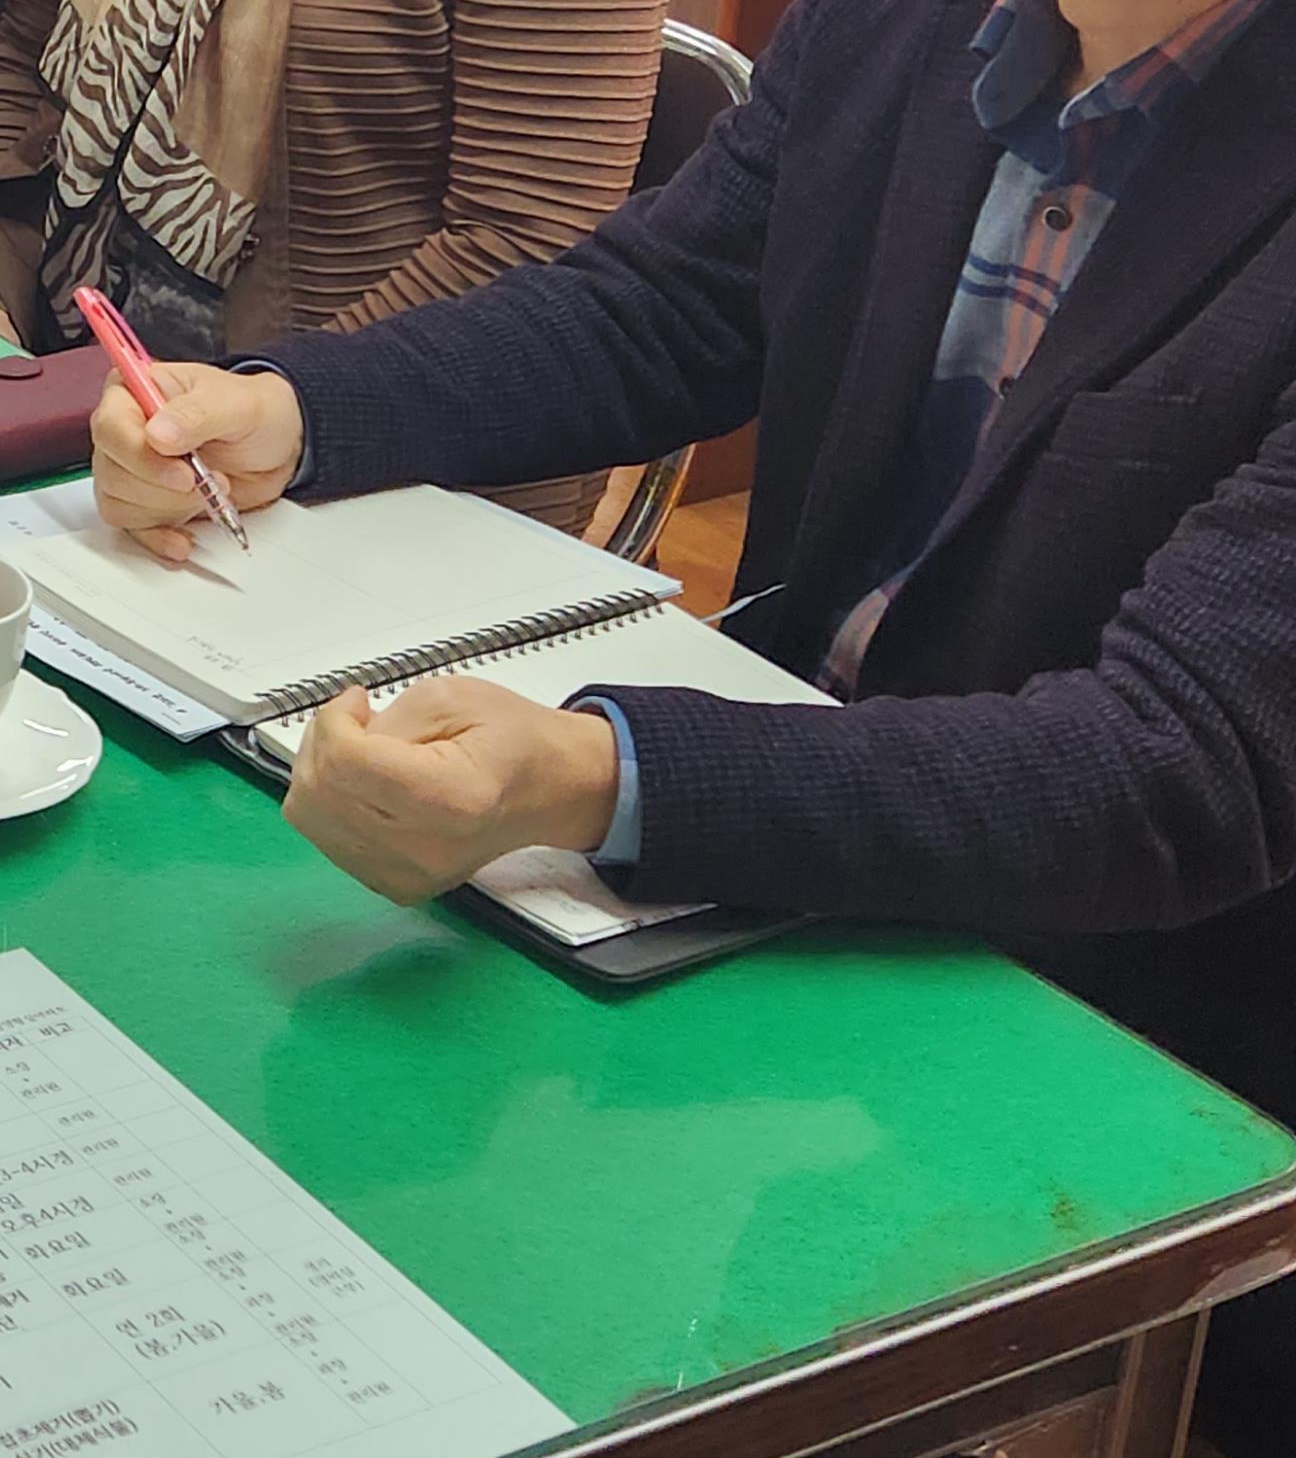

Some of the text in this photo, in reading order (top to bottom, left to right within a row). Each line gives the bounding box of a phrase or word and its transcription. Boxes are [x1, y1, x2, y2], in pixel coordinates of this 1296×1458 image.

[39, 1021, 75, 1038] 비고
[24, 1230, 93, 1260] 화요일
[63, 1267, 130, 1298] 화요일
